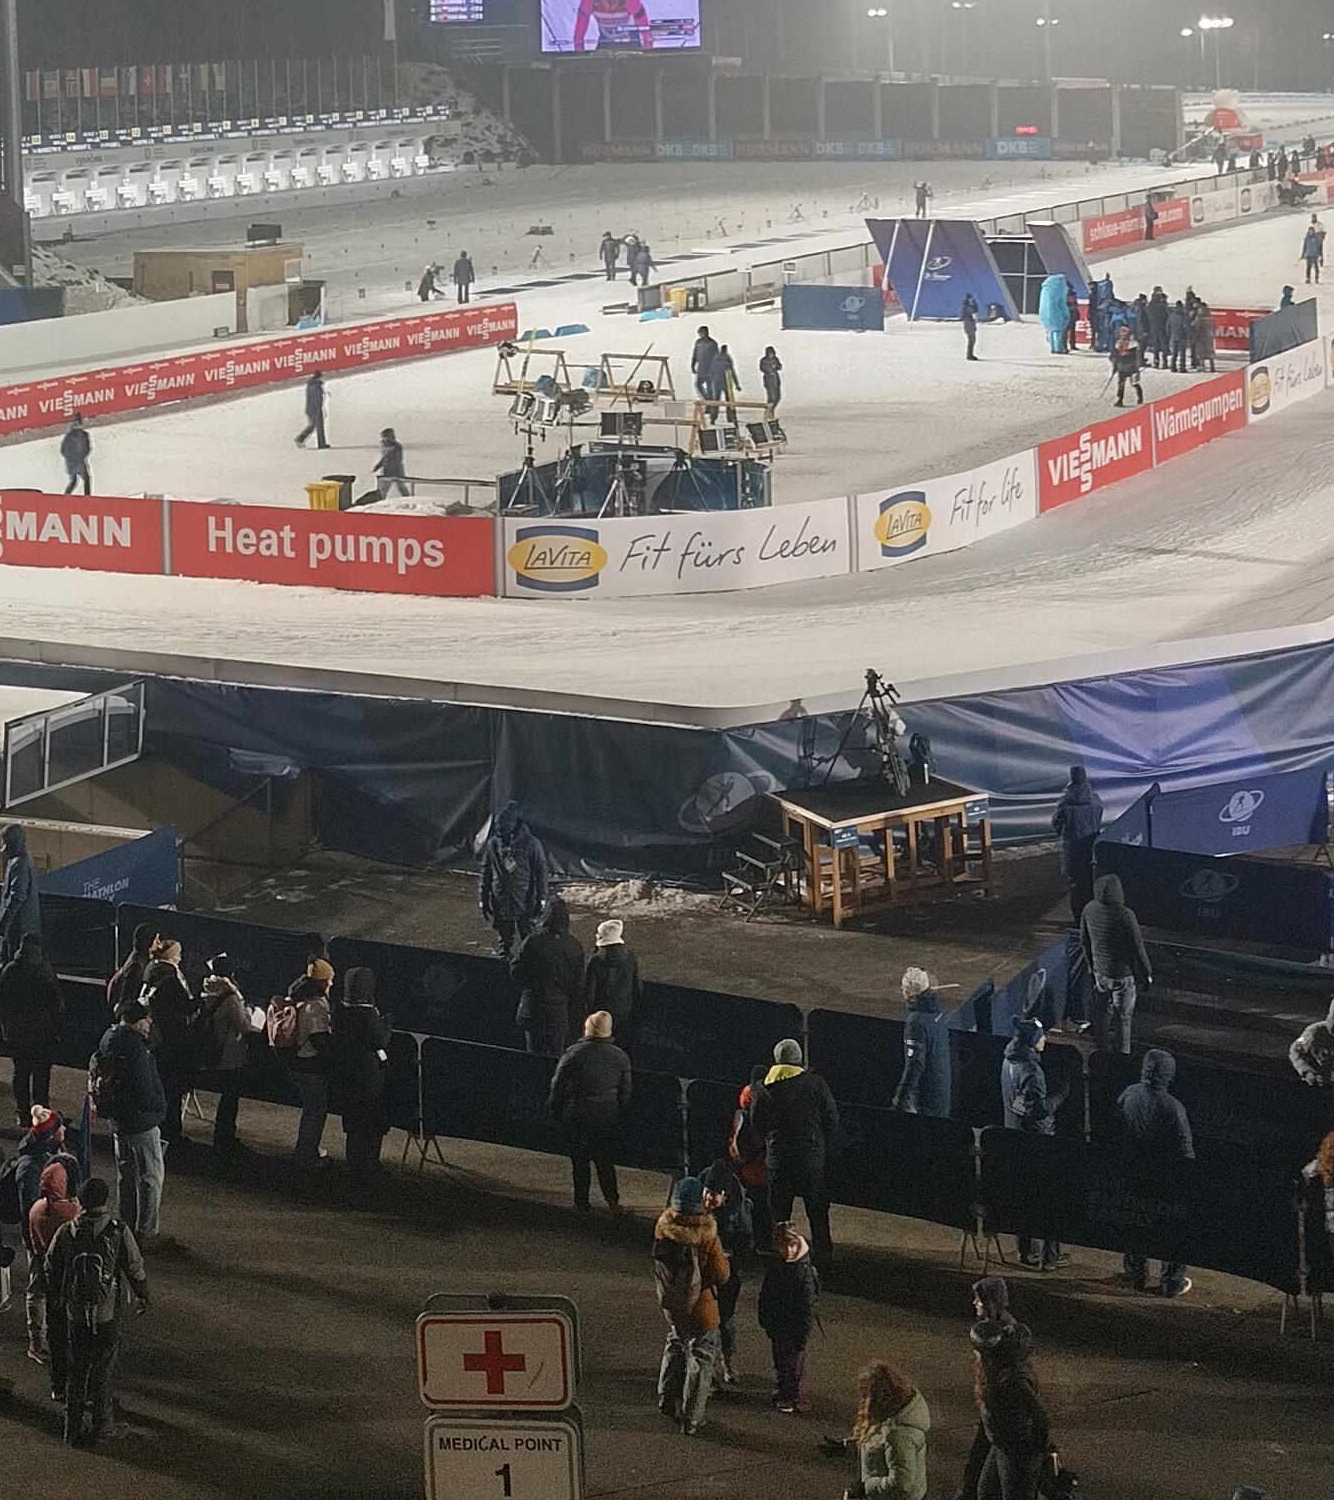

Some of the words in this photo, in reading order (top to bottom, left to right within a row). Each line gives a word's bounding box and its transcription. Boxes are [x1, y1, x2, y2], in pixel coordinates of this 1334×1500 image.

[996, 141, 1027, 154] DKB
[407, 326, 460, 350] VIESSMANN
[467, 318, 515, 340] VIESSMANN
[275, 348, 337, 373] VIESSMANN
[344, 337, 400, 360] VIESSMANN
[204, 359, 270, 386] VIESSMANN
[124, 373, 195, 401] VIESSMANN
[39, 387, 115, 417] VIESSMANN
[1156, 387, 1243, 441] Wärmepumpen
[1048, 425, 1142, 493] VIESSMANN
[950, 488, 974, 526] Fit
[976, 481, 998, 519] for
[1001, 466, 1024, 513] life
[207, 515, 295, 559] Heat
[309, 531, 446, 575] pumps
[619, 530, 671, 573] Fit
[677, 531, 745, 581] fürs
[759, 515, 838, 560] Leben
[1232, 826, 1250, 836] IBU
[82, 877, 101, 892] THE
[439, 1436, 510, 1451] MEDICAL
[516, 1438, 563, 1451] POINT
[495, 1463, 511, 1497] 1
